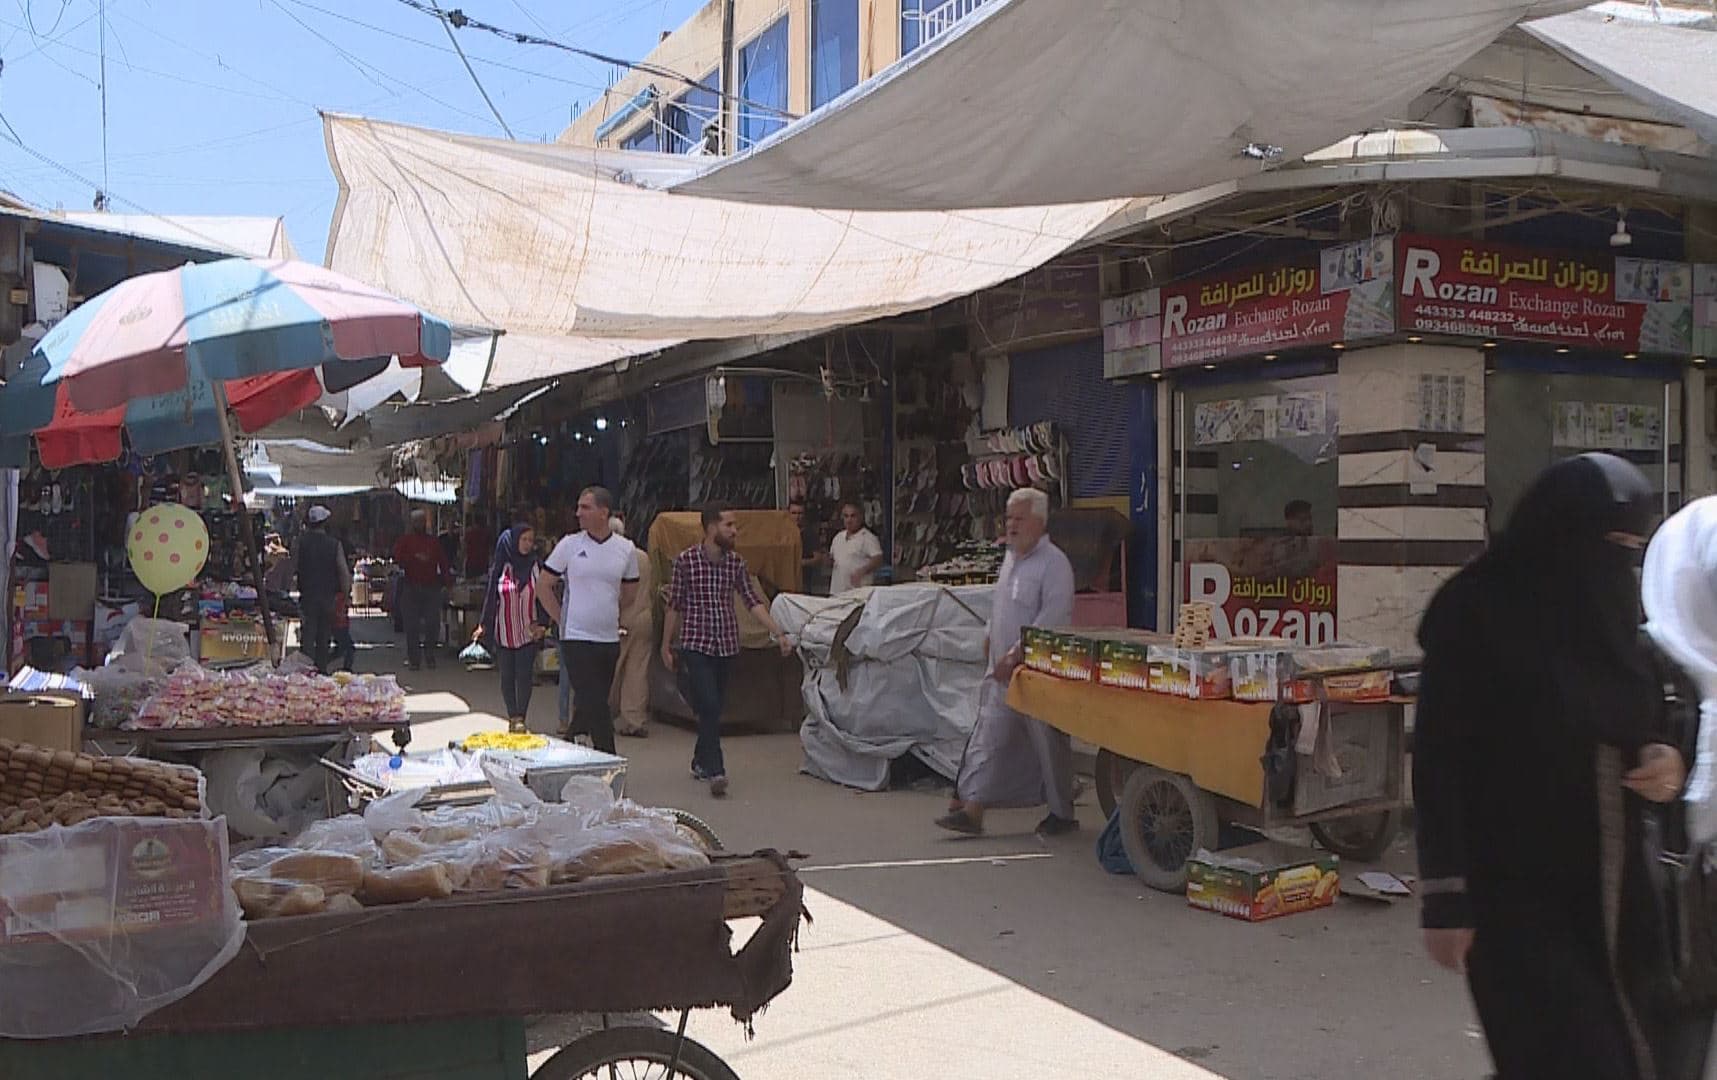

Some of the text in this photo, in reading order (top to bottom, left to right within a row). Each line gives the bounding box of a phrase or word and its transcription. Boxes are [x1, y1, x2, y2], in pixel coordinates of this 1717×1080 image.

[1200, 267, 1315, 308] روزان للصرافة
[1401, 247, 1498, 305] Rozan
[1460, 249, 1609, 294] روزان للصرافة
[1163, 294, 1227, 339] Rozan
[1234, 297, 1331, 329] Exchange Rozan
[1508, 290, 1626, 320] Exchange Rozan
[1189, 562, 1335, 648] Rozan
[1232, 575, 1332, 606] روزان للصرافة
